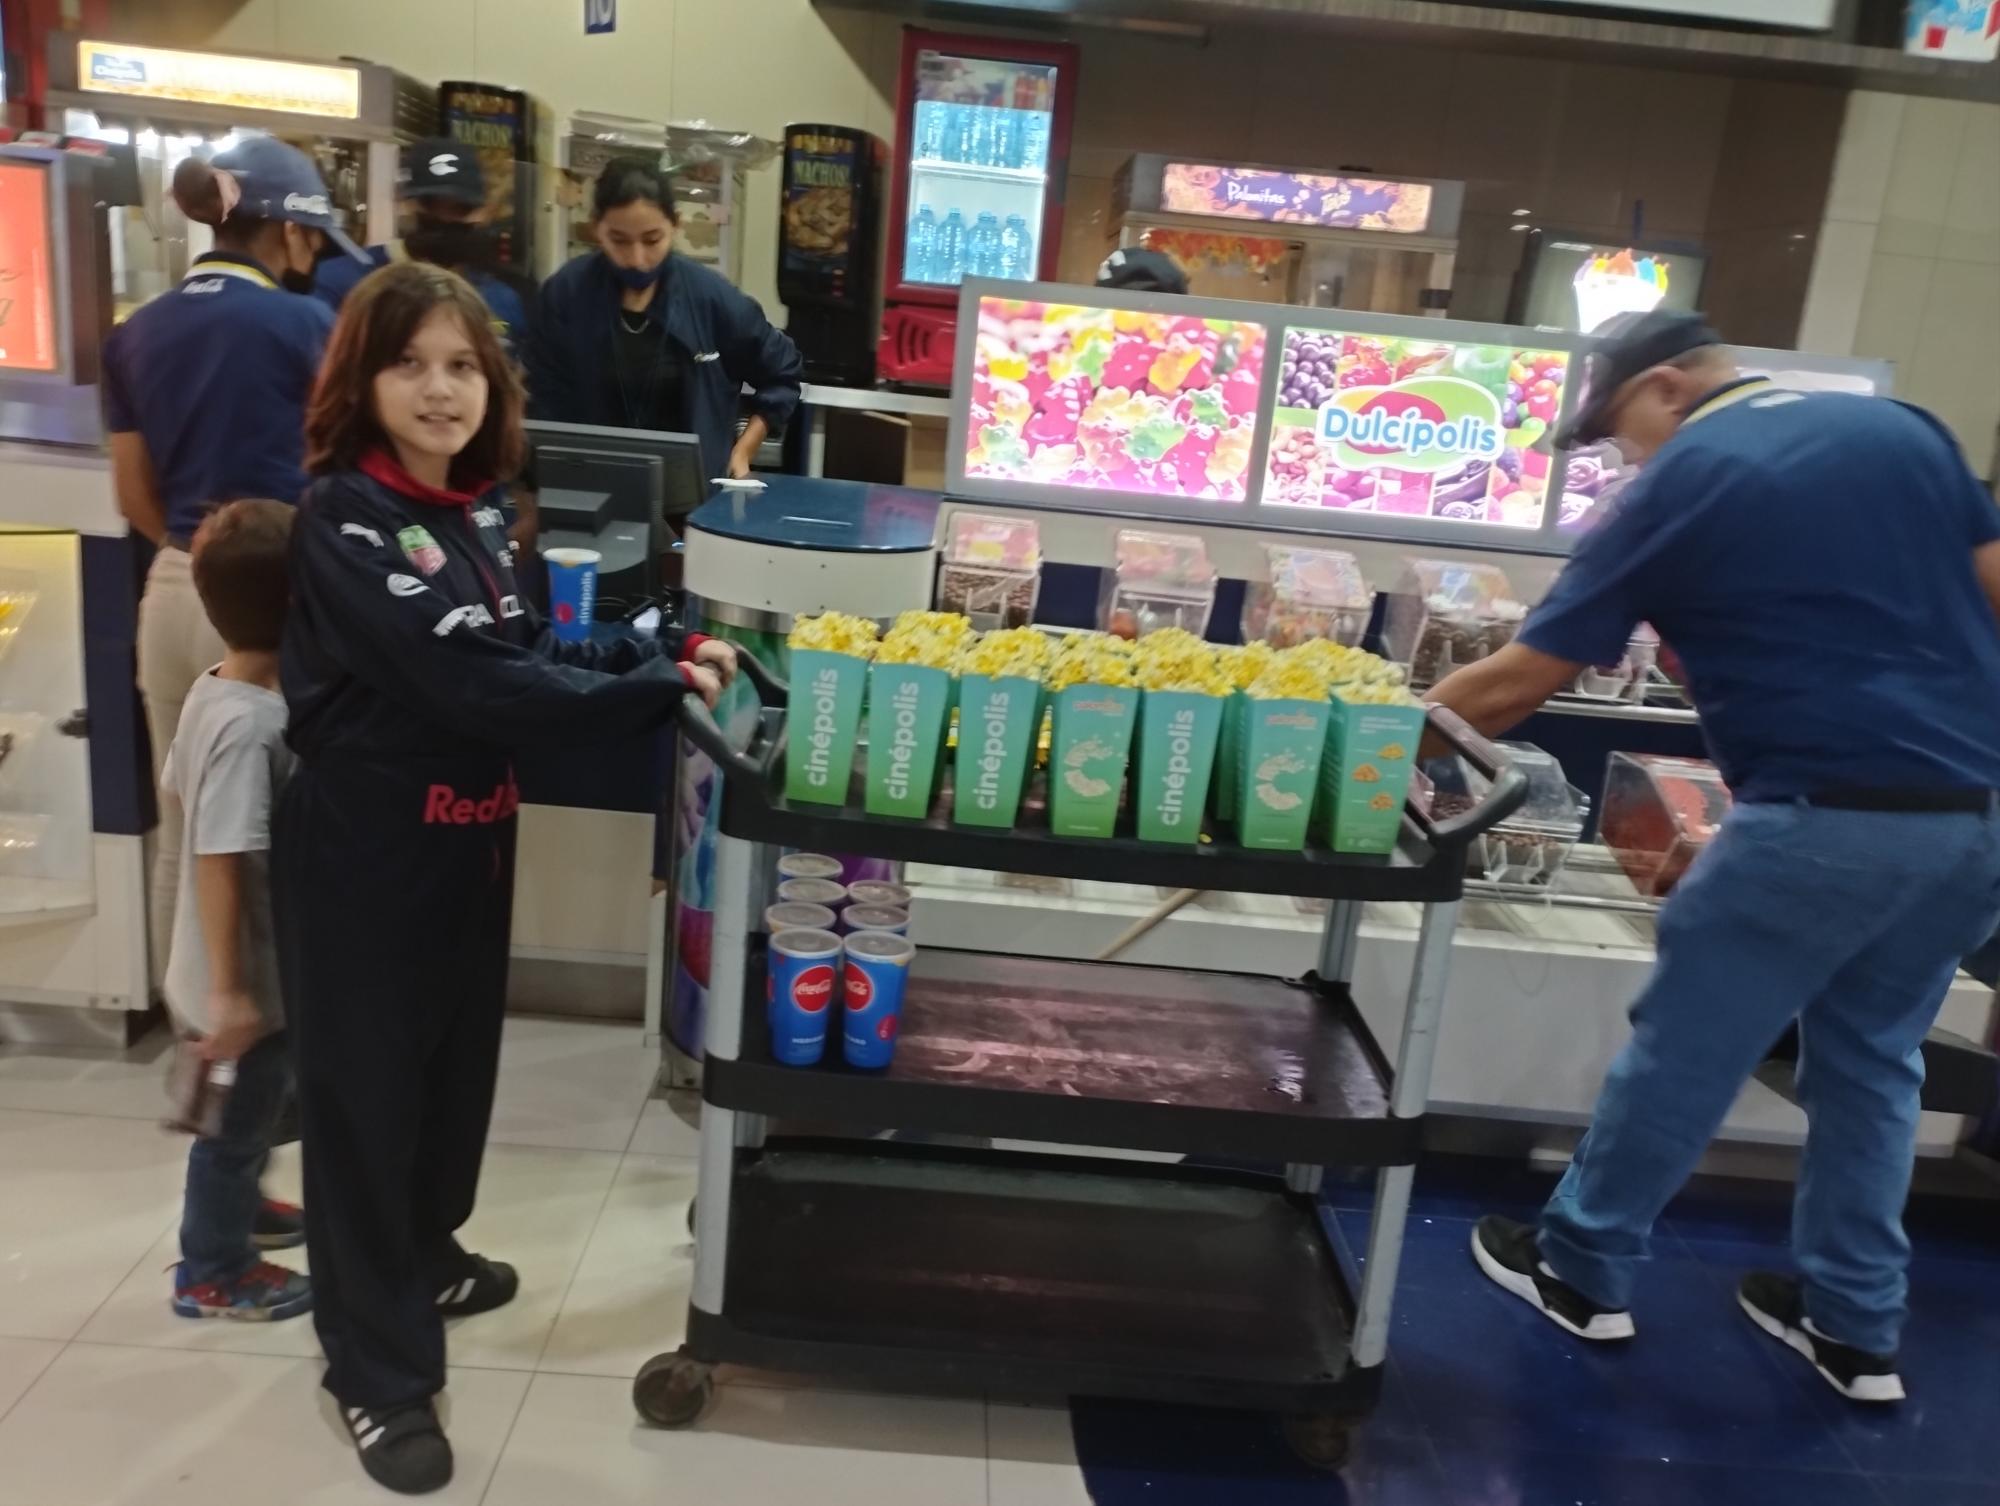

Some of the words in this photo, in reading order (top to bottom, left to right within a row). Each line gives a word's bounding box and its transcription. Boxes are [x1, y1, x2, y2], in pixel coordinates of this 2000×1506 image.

[1227, 181, 1287, 205] Palomitas
[1323, 407, 1497, 453] Dulcípolis
[577, 571, 593, 625] cinépolis
[803, 668, 839, 787] cinépolis
[883, 682, 919, 800] cinépolis
[972, 691, 1010, 810] cinépolis
[1156, 709, 1195, 826] cinépolis
